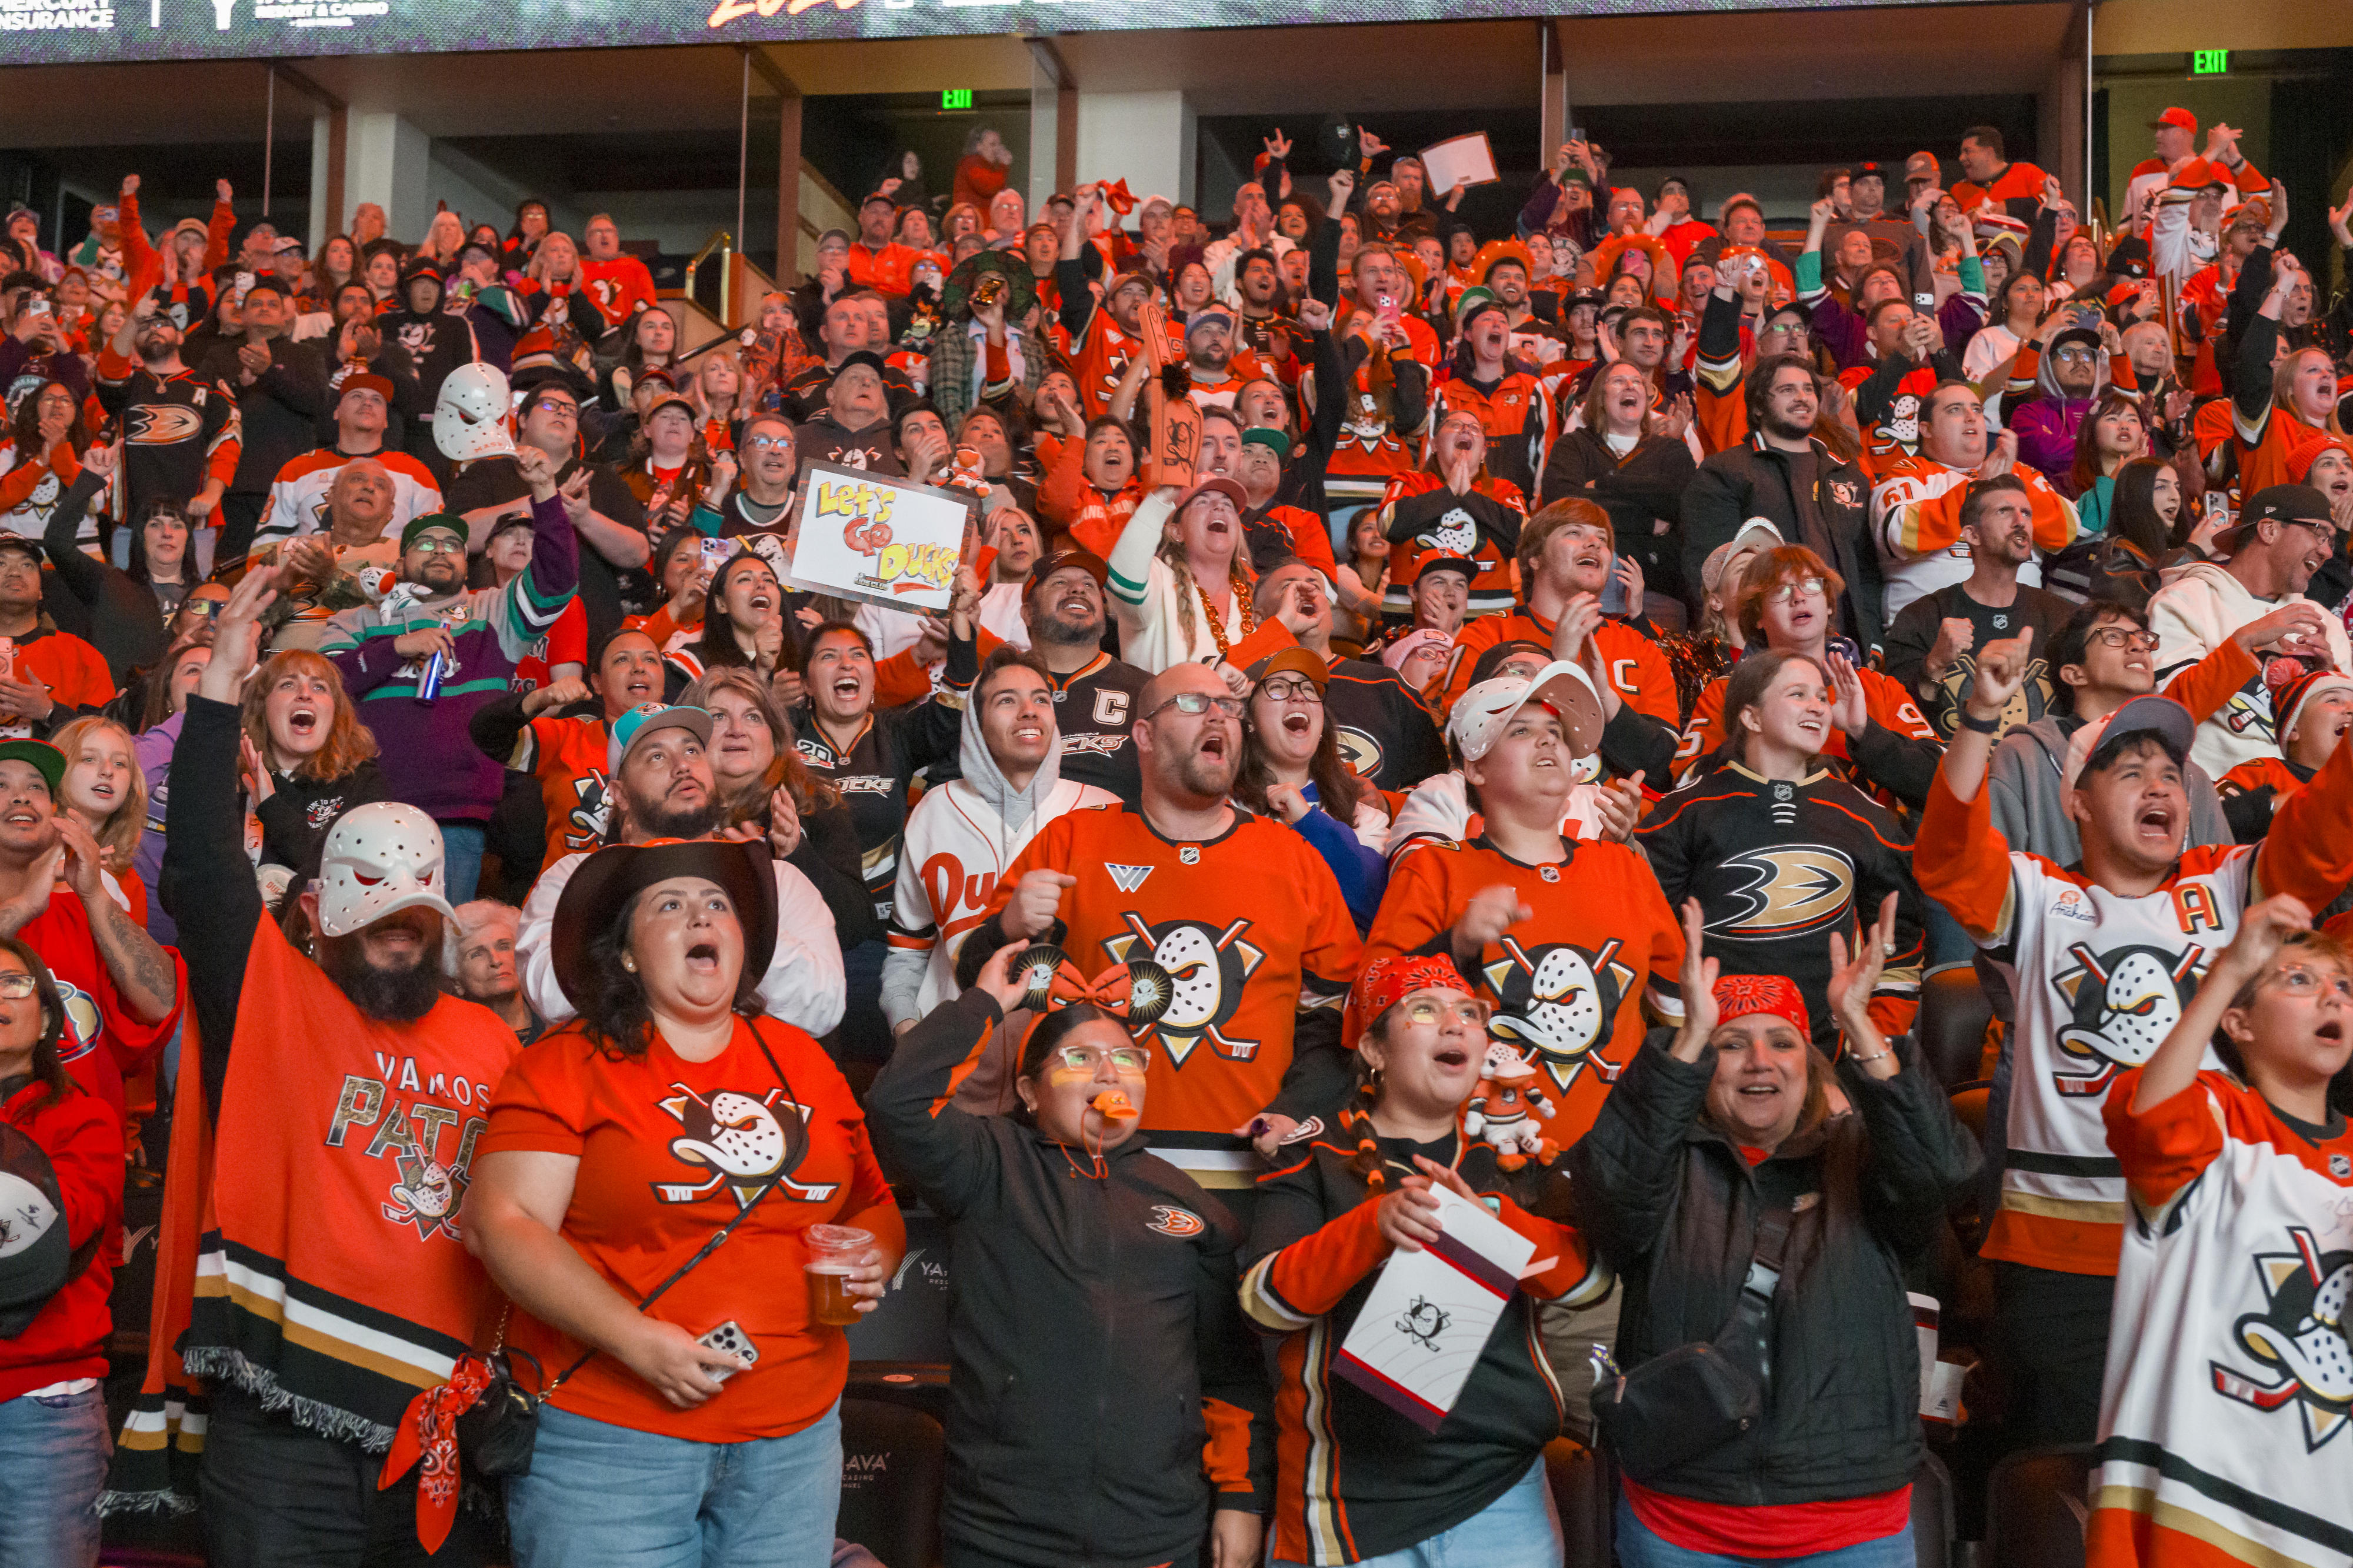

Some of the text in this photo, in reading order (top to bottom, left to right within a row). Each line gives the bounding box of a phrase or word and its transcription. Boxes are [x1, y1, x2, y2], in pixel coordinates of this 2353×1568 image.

[0, 9, 115, 30] NSURANCE
[2194, 49, 2228, 74] EXIT
[942, 89, 972, 109] EXIT
[191, 386, 207, 406] A
[815, 481, 896, 523] Let's
[1884, 482, 1914, 508] 61
[1613, 659, 1641, 695] C
[1093, 688, 1129, 726] C
[2171, 882, 2225, 935] A
[374, 1050, 490, 1113] VAMOS
